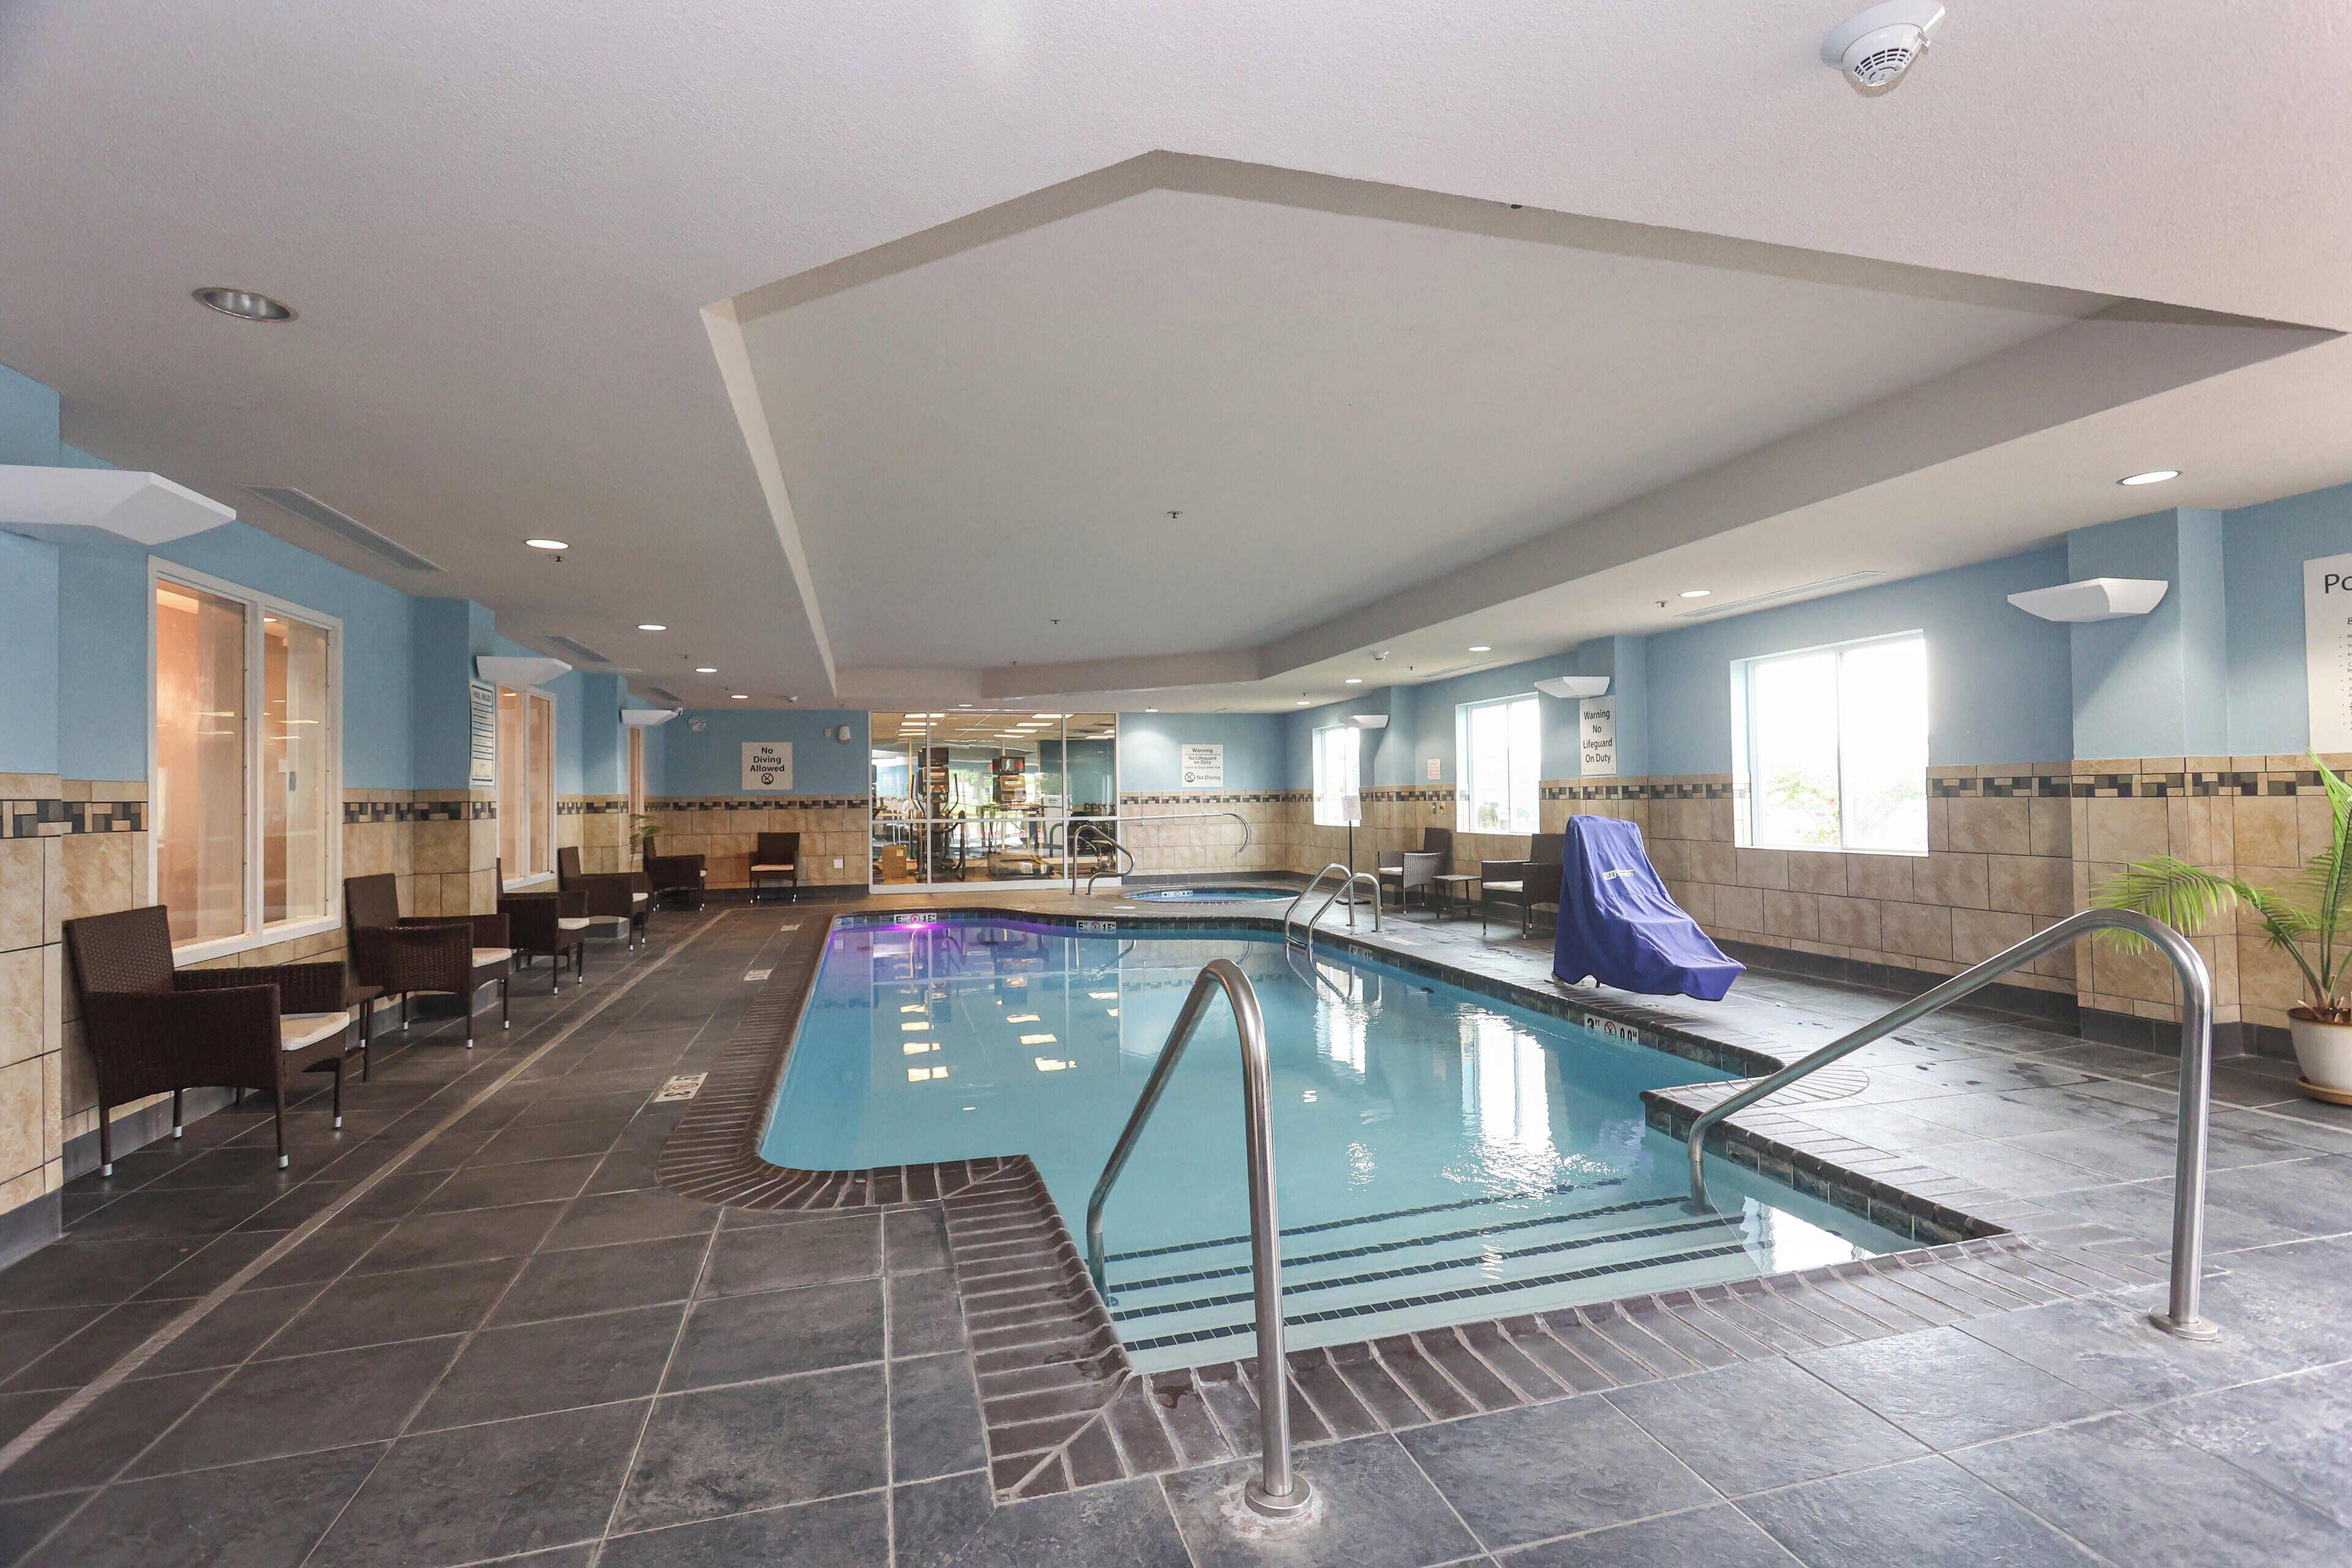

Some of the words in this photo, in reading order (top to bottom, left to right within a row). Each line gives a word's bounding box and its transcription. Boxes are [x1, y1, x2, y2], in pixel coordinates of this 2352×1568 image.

[1584, 709, 1610, 720] Warning
[1593, 725, 1602, 734] No
[1583, 737, 1613, 750] Lifeguard
[753, 756, 781, 764] Diving
[1585, 754, 1594, 763] On
[1596, 753, 1611, 764] Duty
